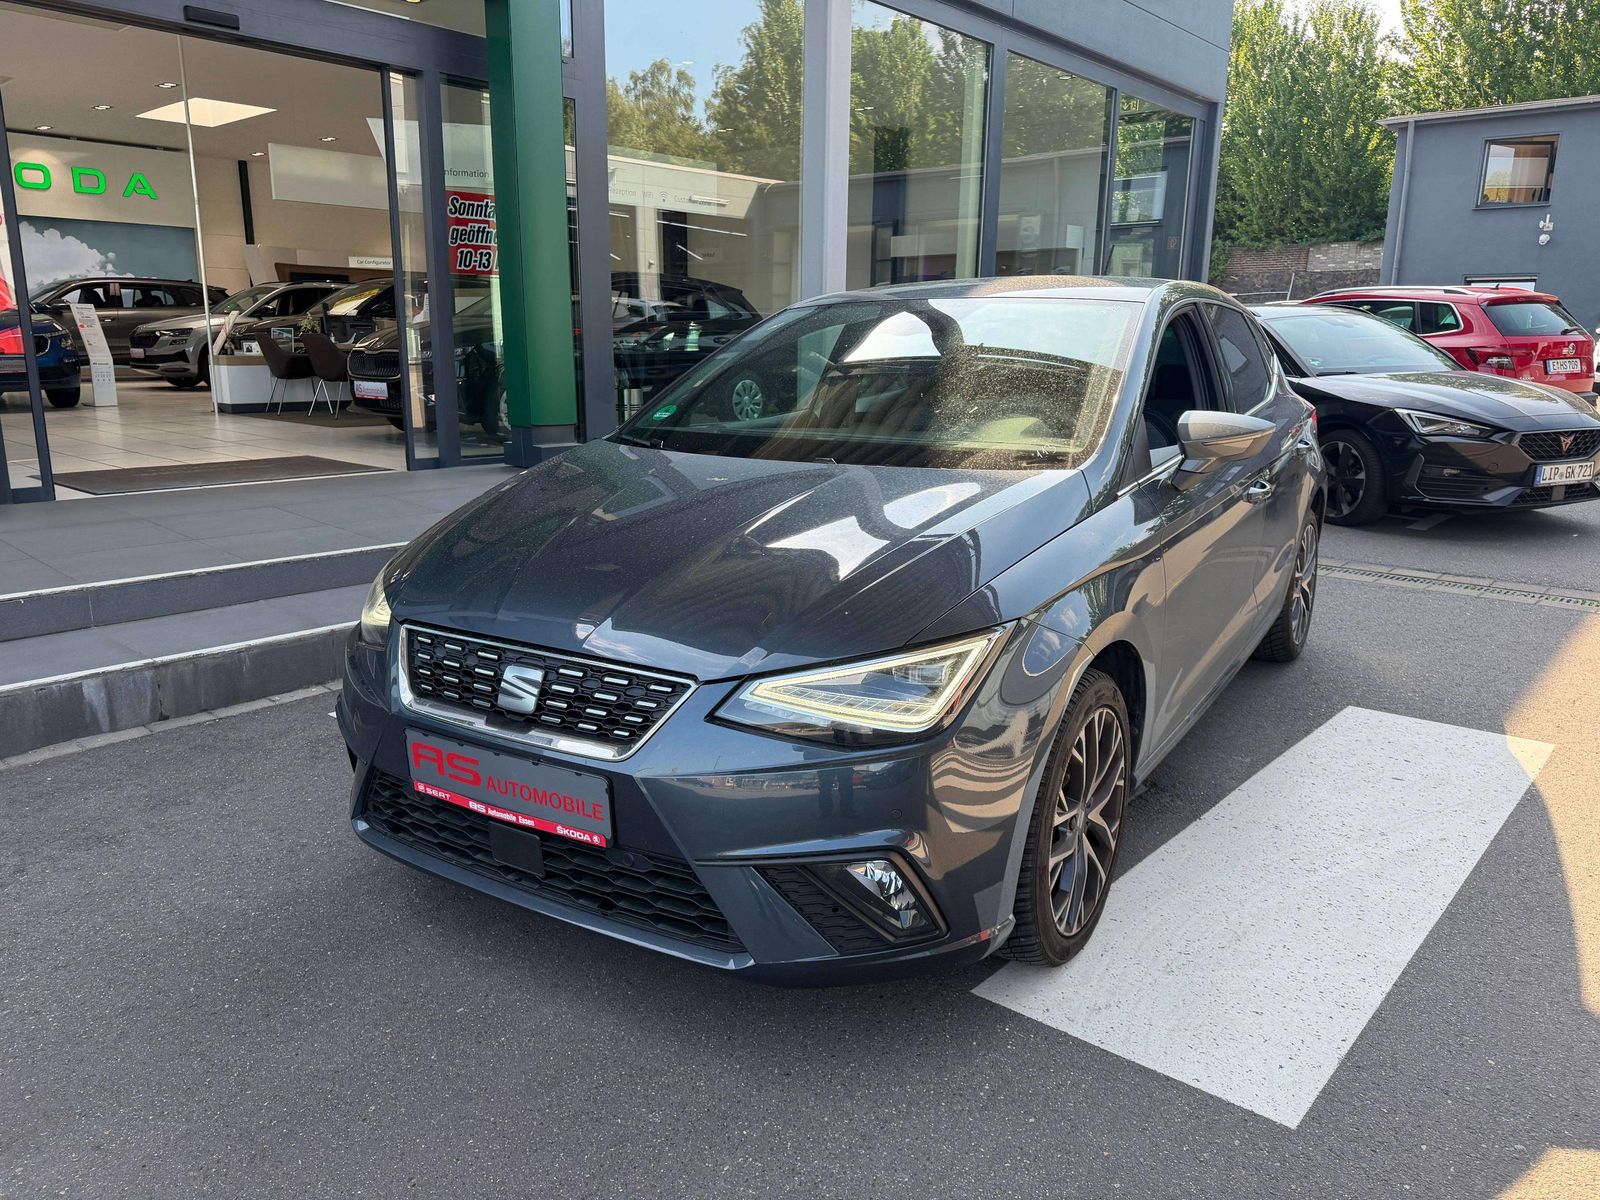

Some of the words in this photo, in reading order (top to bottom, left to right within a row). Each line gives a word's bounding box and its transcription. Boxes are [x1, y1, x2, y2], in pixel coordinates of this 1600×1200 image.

[456, 247, 493, 270] 10-13
[1541, 466, 1560, 481] LIP
[411, 740, 482, 787] AS
[486, 775, 605, 821] AUTOMOBILE
[425, 786, 452, 801] SEAT
[487, 807, 517, 822] Automobile
[518, 815, 535, 827] Essen
[556, 825, 592, 842] ŠKODA
